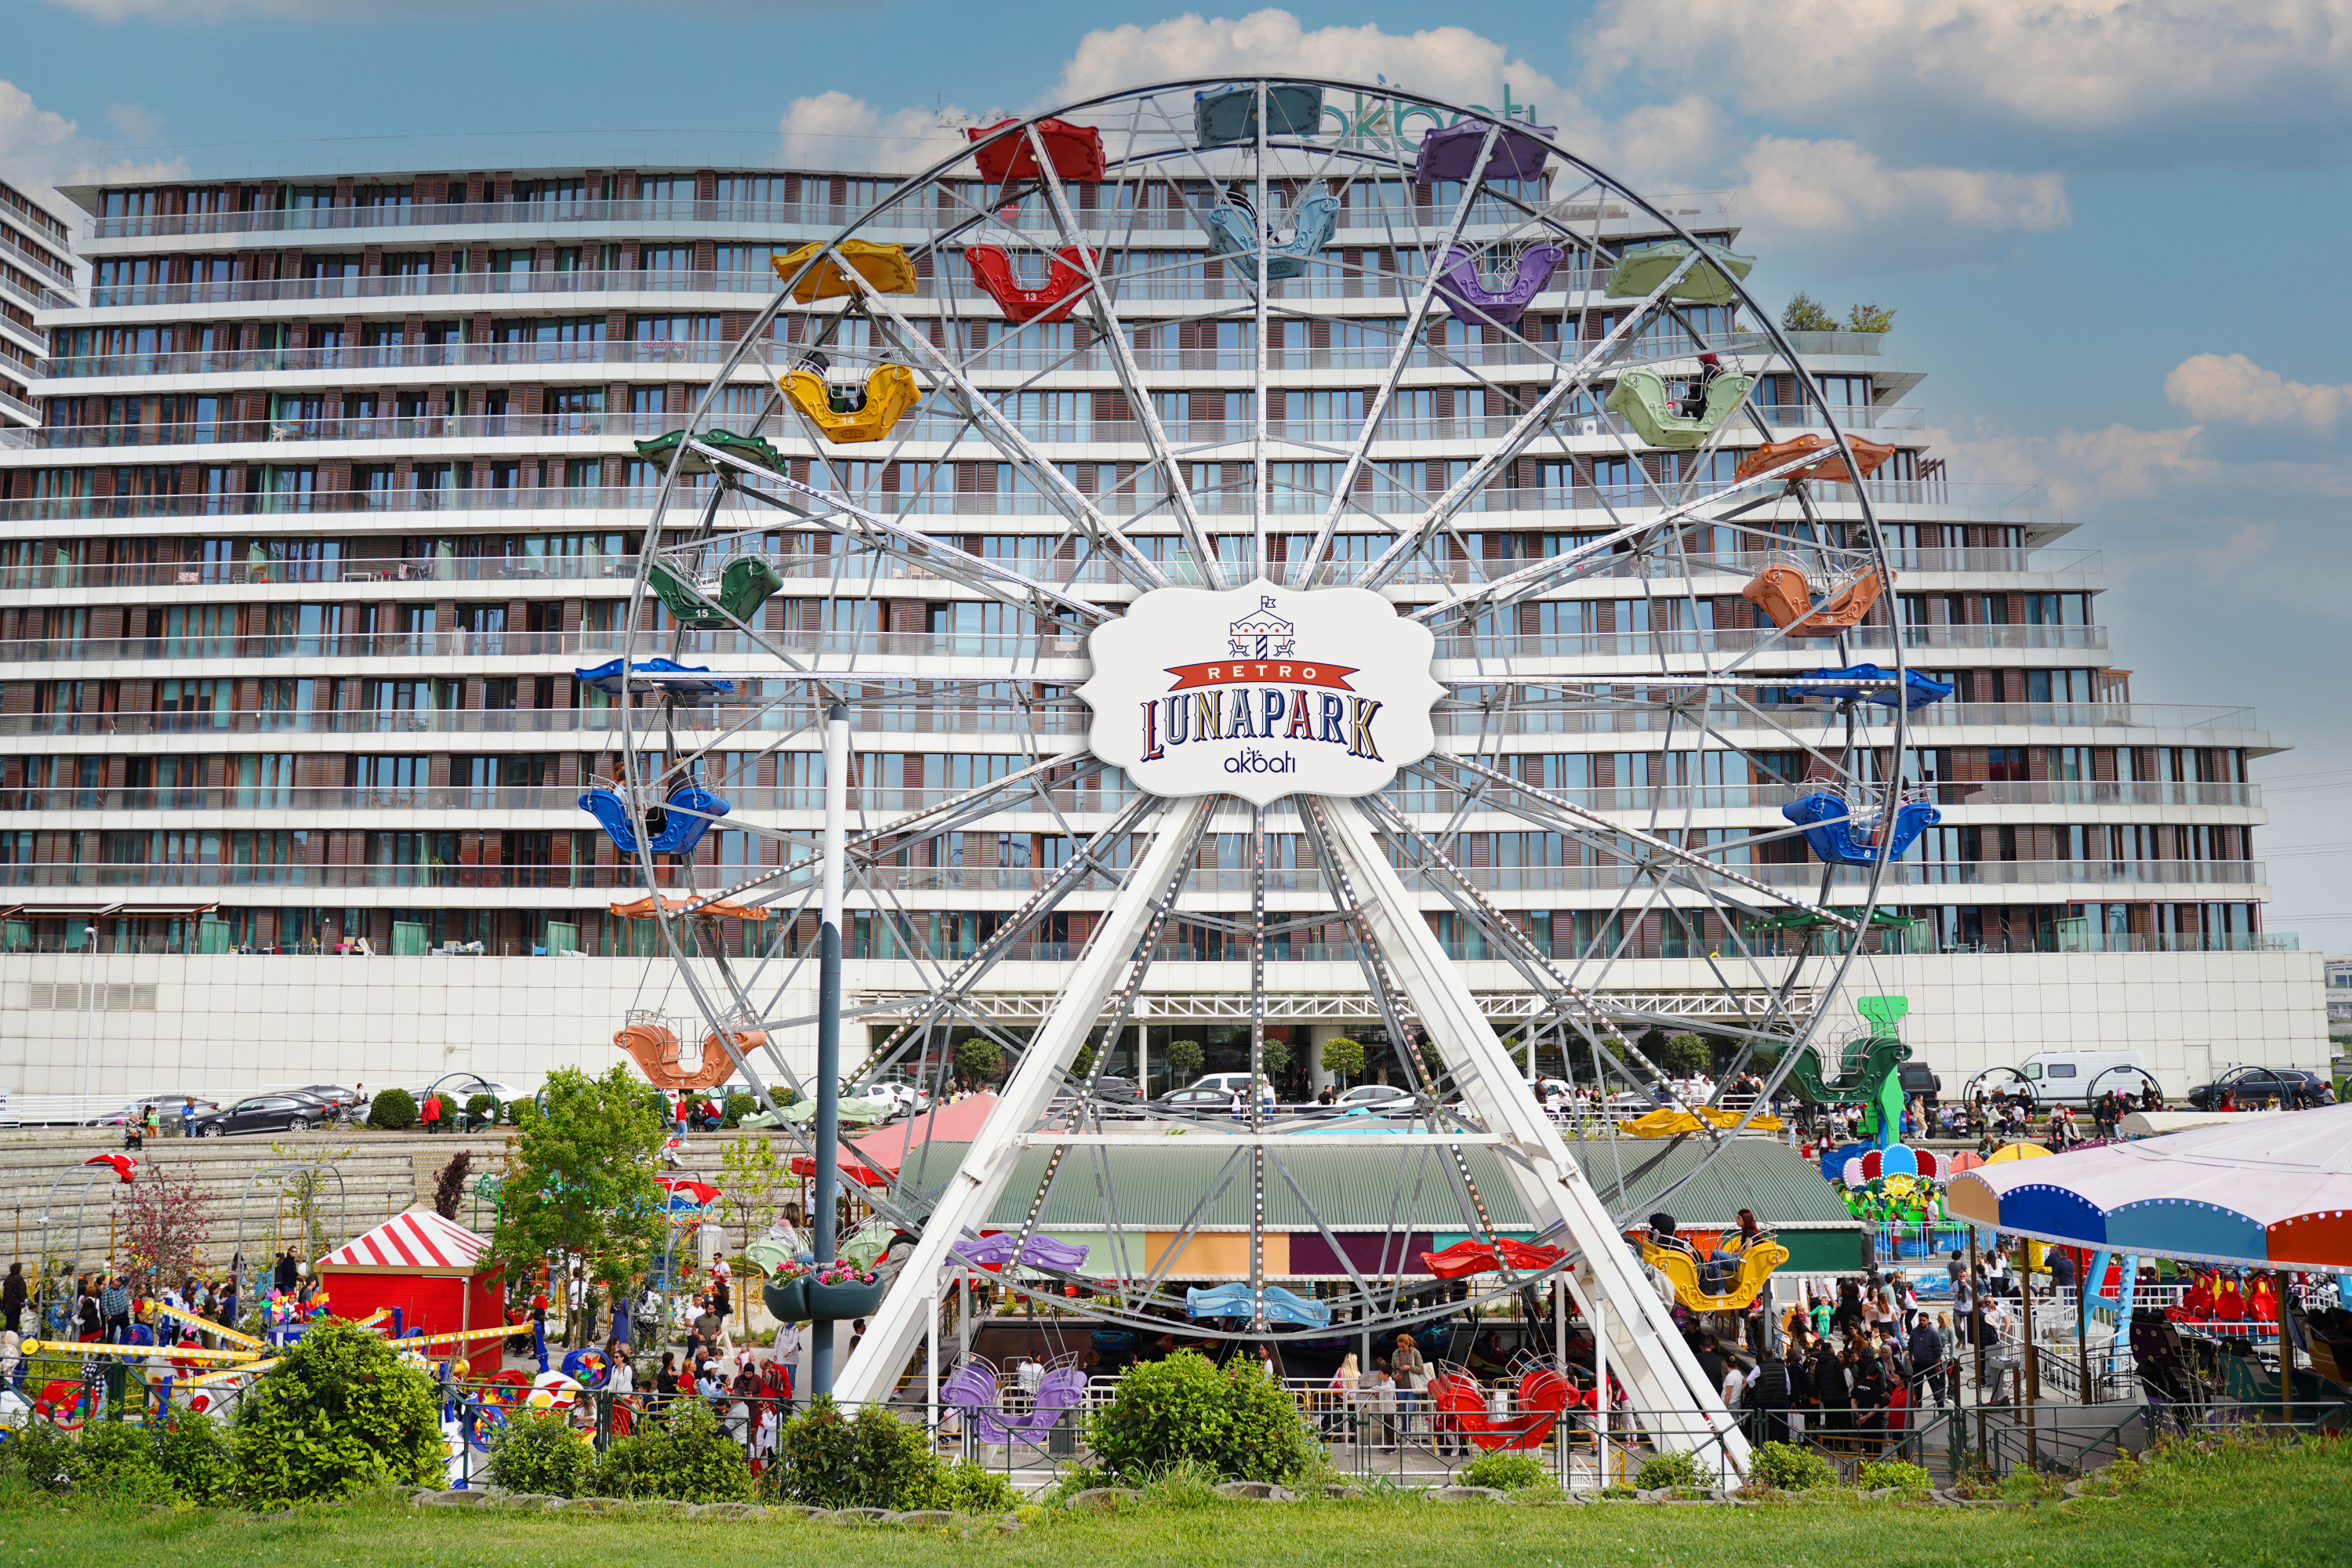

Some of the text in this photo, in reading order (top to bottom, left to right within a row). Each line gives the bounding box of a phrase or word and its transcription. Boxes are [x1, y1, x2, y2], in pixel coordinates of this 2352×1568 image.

[1024, 292, 1036, 301] 13
[841, 416, 854, 425] 14
[1680, 420, 1693, 429] 10
[695, 608, 708, 618] 15
[1207, 664, 1317, 680] RETRO
[1140, 688, 1385, 763] LUNAPARK
[1864, 849, 1871, 858] 8
